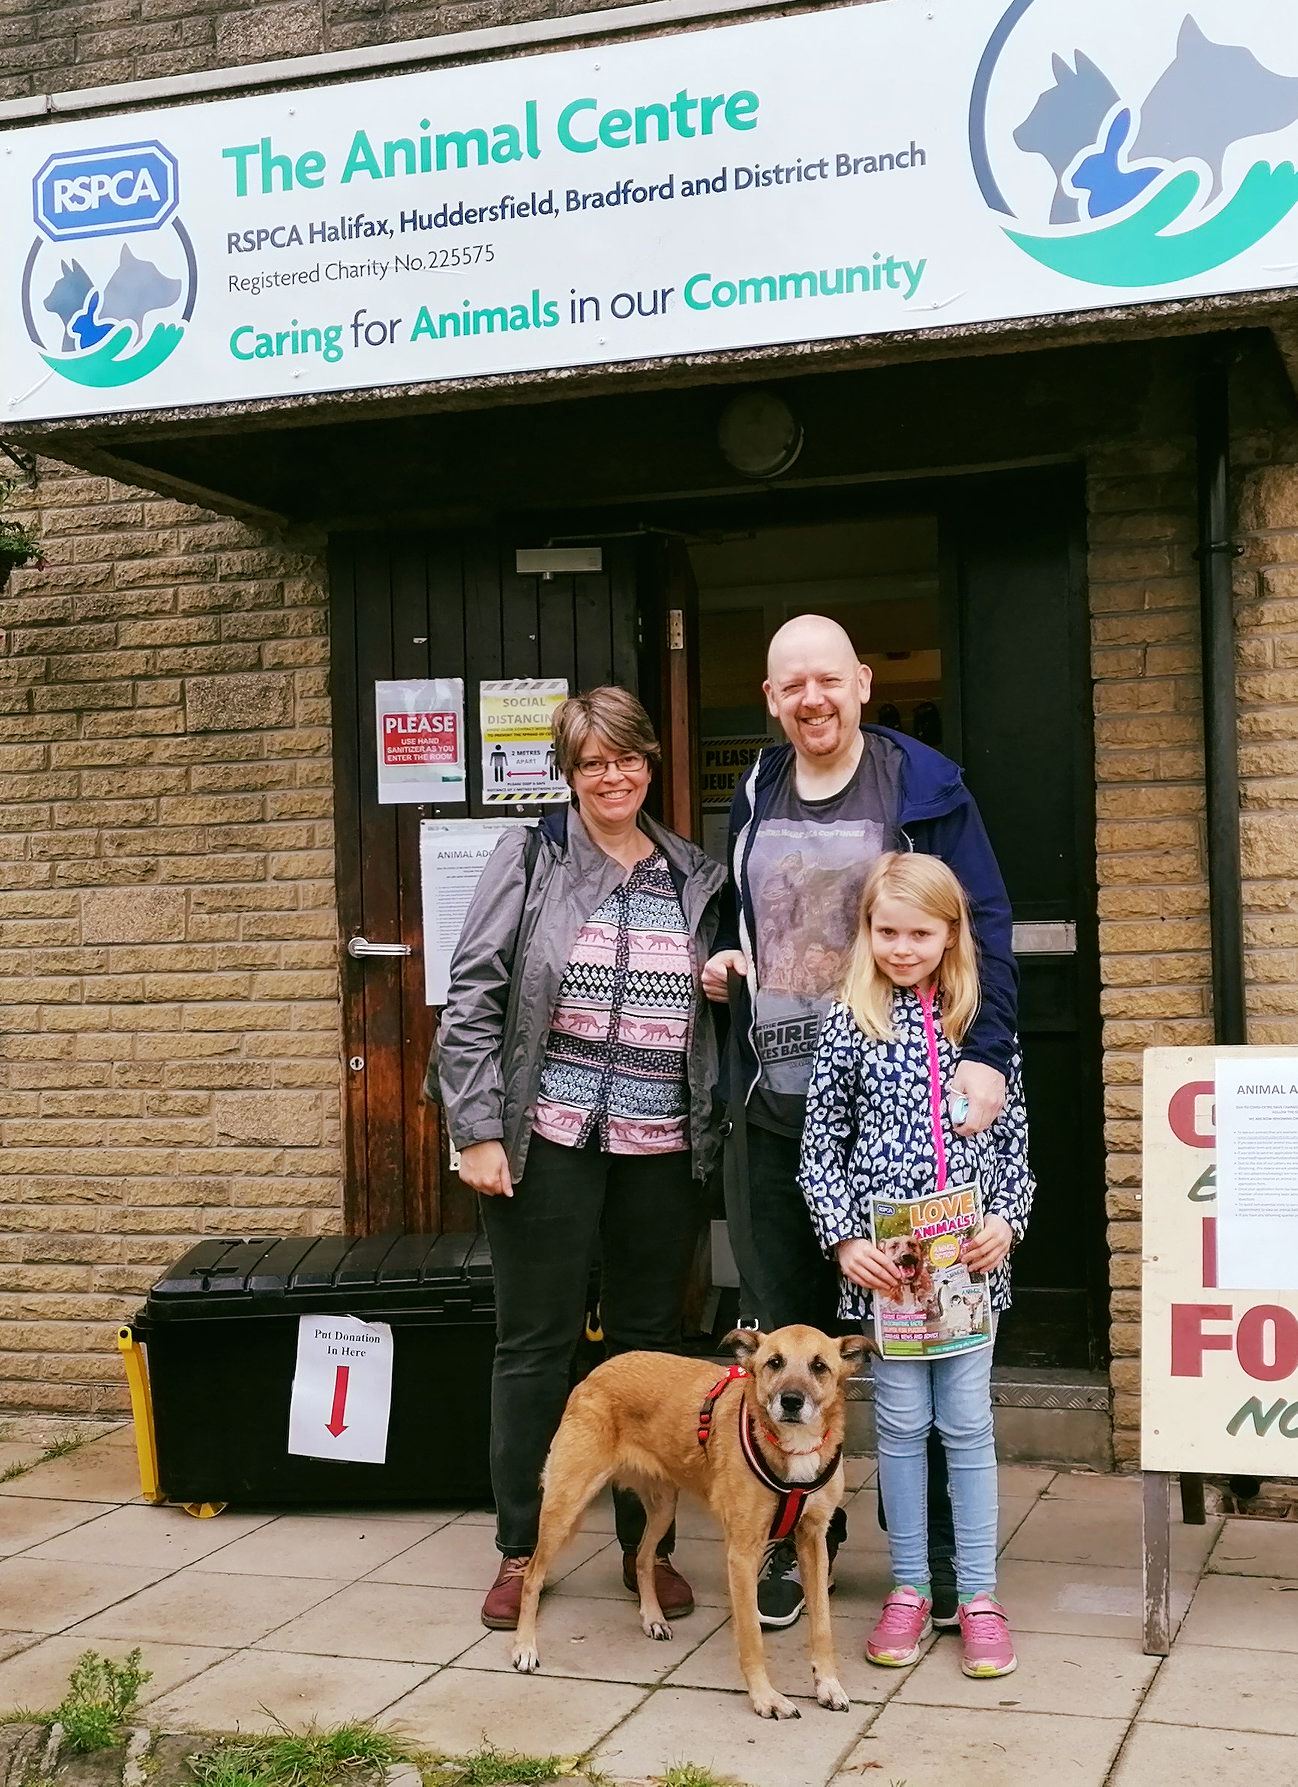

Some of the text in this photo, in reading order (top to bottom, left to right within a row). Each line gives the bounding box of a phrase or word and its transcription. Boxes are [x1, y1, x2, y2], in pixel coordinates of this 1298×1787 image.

[222, 88, 760, 197] The Animal Centre
[53, 167, 160, 214] RSPCA
[227, 141, 926, 254] RSPCA Halifax, Huddersfield, Bradford and District Branch
[228, 243, 496, 295] Registered Charity No.225575
[230, 251, 927, 363] Caring for Animals in our Community
[503, 697, 546, 708] SOCIAL
[386, 716, 454, 734] PLEASE
[488, 714, 553, 725] DISTANCIN
[387, 745, 454, 754] SANITIZER AS YOU
[387, 754, 412, 762] ENTER
[706, 749, 757, 767] PLEASE
[437, 850, 473, 859] ANIMAL
[1237, 1085, 1286, 1094] ANIMAL
[911, 1191, 975, 1228] LOVE
[315, 1329, 381, 1344] Put Donation
[327, 1345, 367, 1357] In Here
